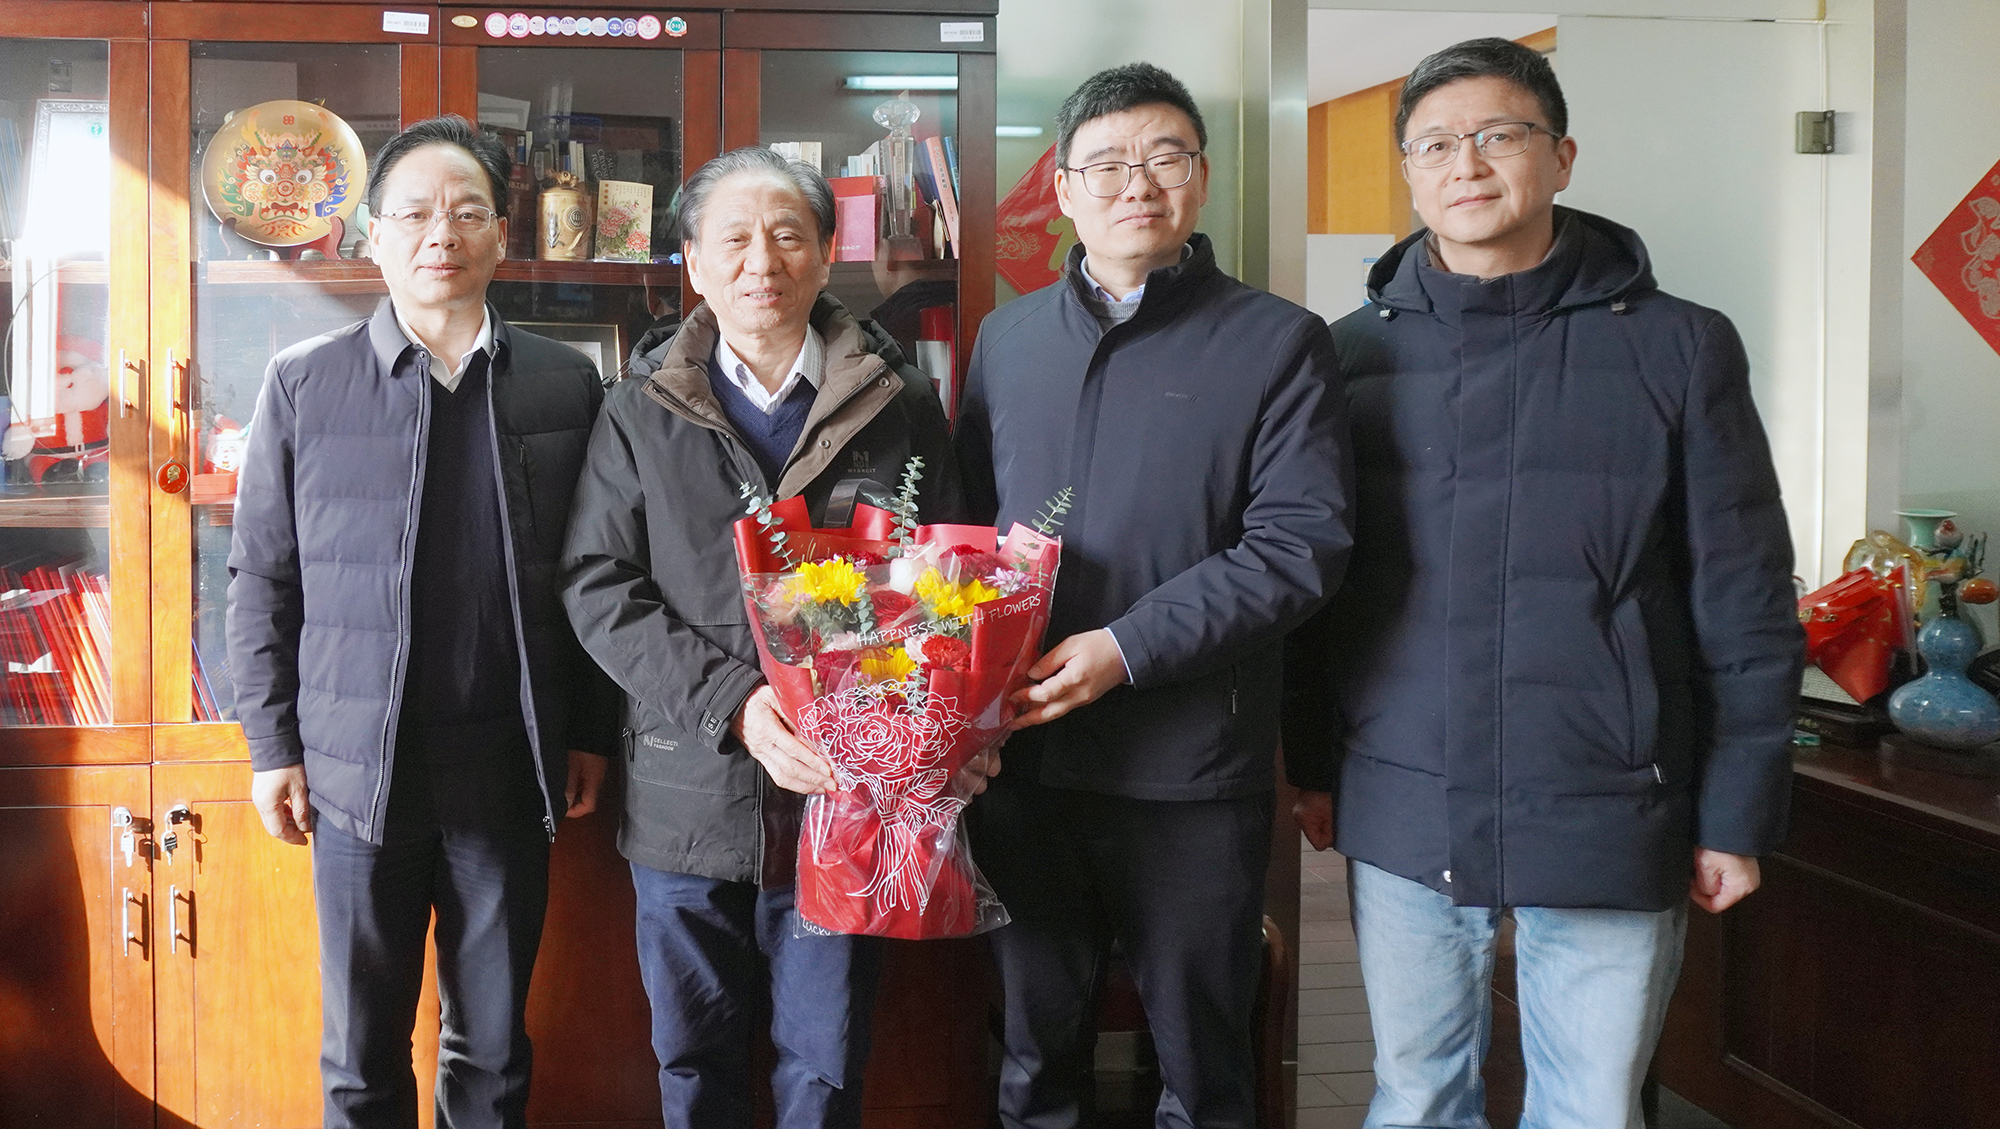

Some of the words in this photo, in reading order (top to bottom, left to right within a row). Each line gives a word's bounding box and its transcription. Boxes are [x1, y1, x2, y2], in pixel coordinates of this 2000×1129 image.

[590, 153, 600, 170] FOR
[856, 620, 938, 647] HAPPNESS
[940, 608, 985, 632] WITH
[988, 592, 1041, 623] FLOWERS
